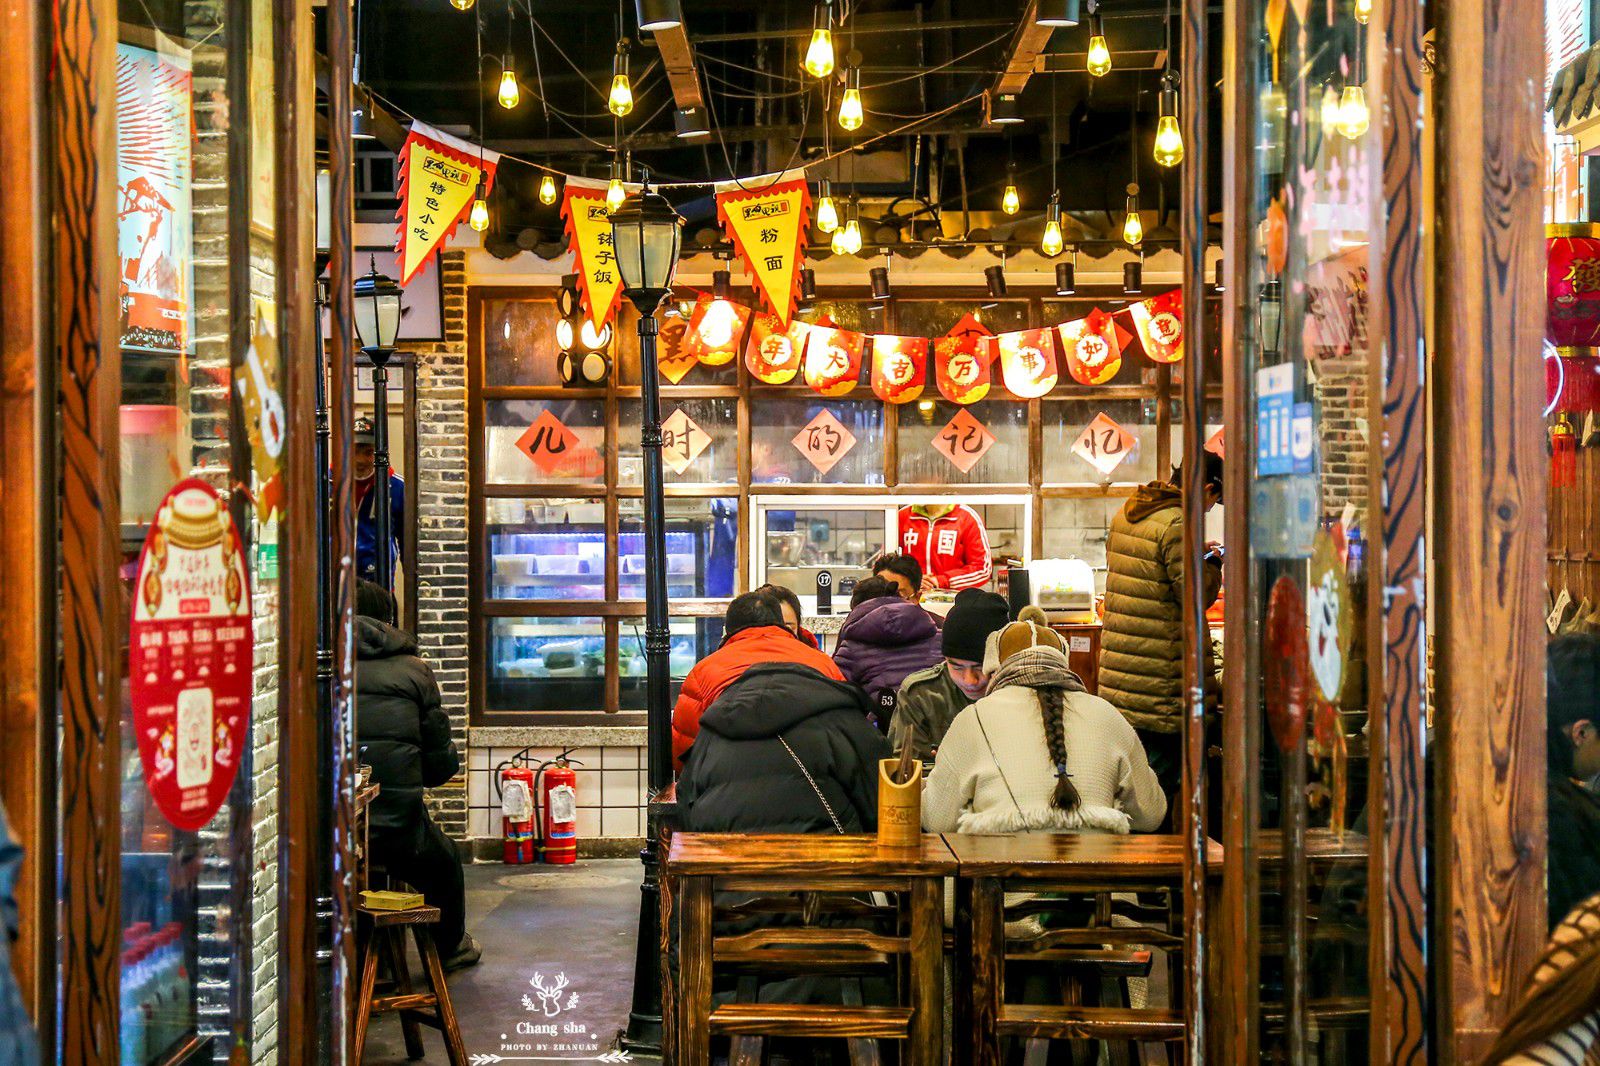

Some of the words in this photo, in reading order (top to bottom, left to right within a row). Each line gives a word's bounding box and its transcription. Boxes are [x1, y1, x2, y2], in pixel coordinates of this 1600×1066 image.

[413, 181, 447, 242] 特色小吃
[593, 231, 616, 285] 钵子饭
[760, 227, 784, 272] 粉面
[903, 527, 958, 557] 中国
[820, 575, 829, 584] 17
[881, 695, 893, 706] 53
